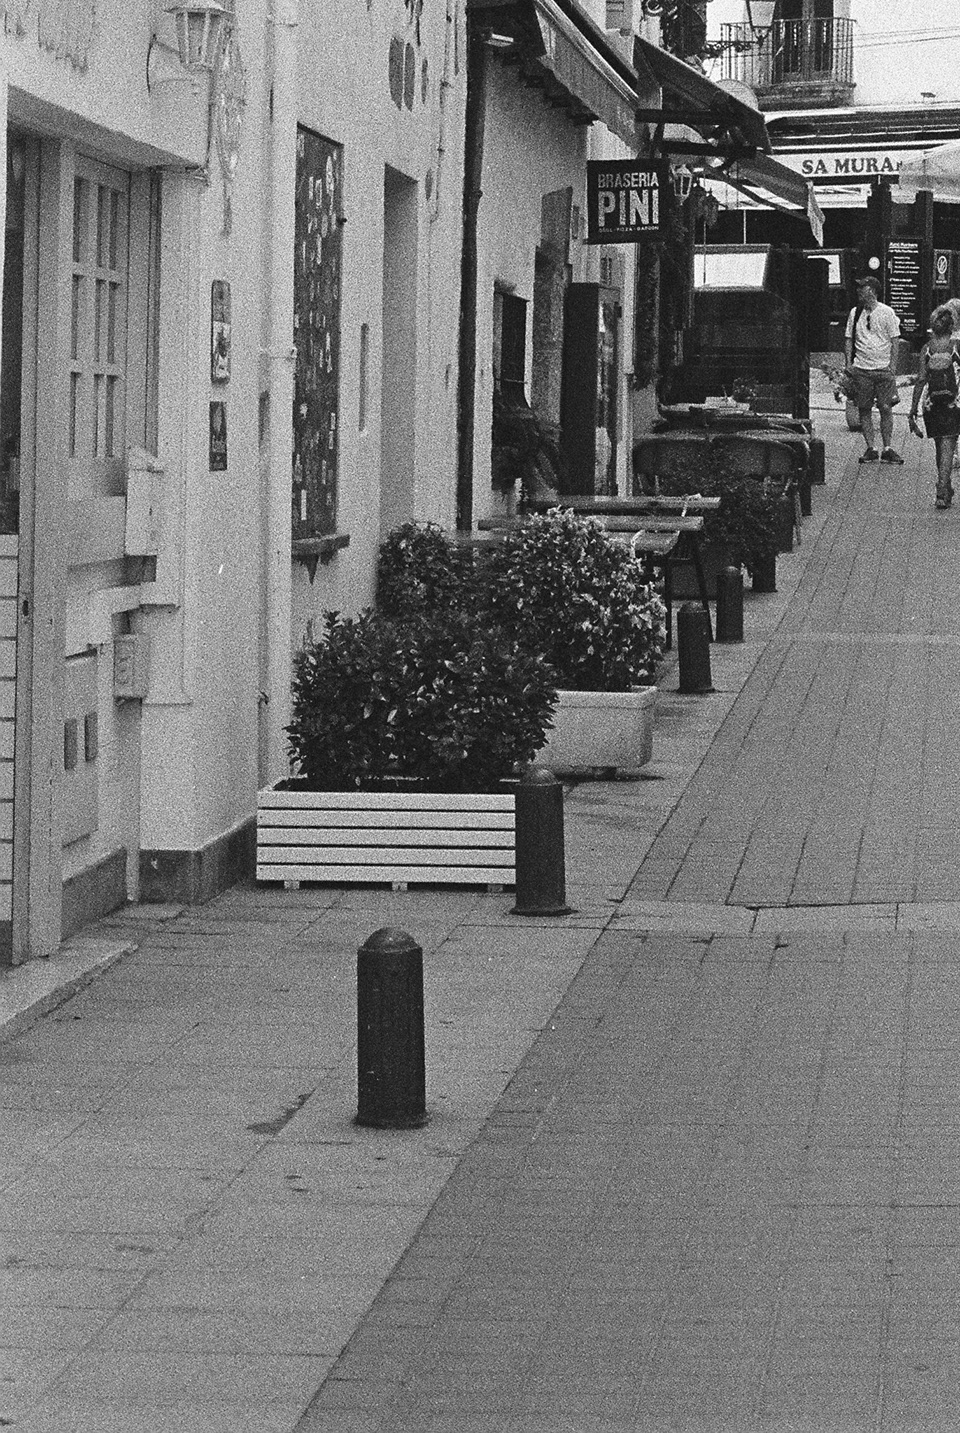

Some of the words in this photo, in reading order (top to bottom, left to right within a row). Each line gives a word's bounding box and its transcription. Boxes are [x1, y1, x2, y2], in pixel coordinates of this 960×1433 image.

[802, 159, 828, 174] SA
[597, 171, 660, 188] BRASERIA
[598, 188, 660, 227] PINI
